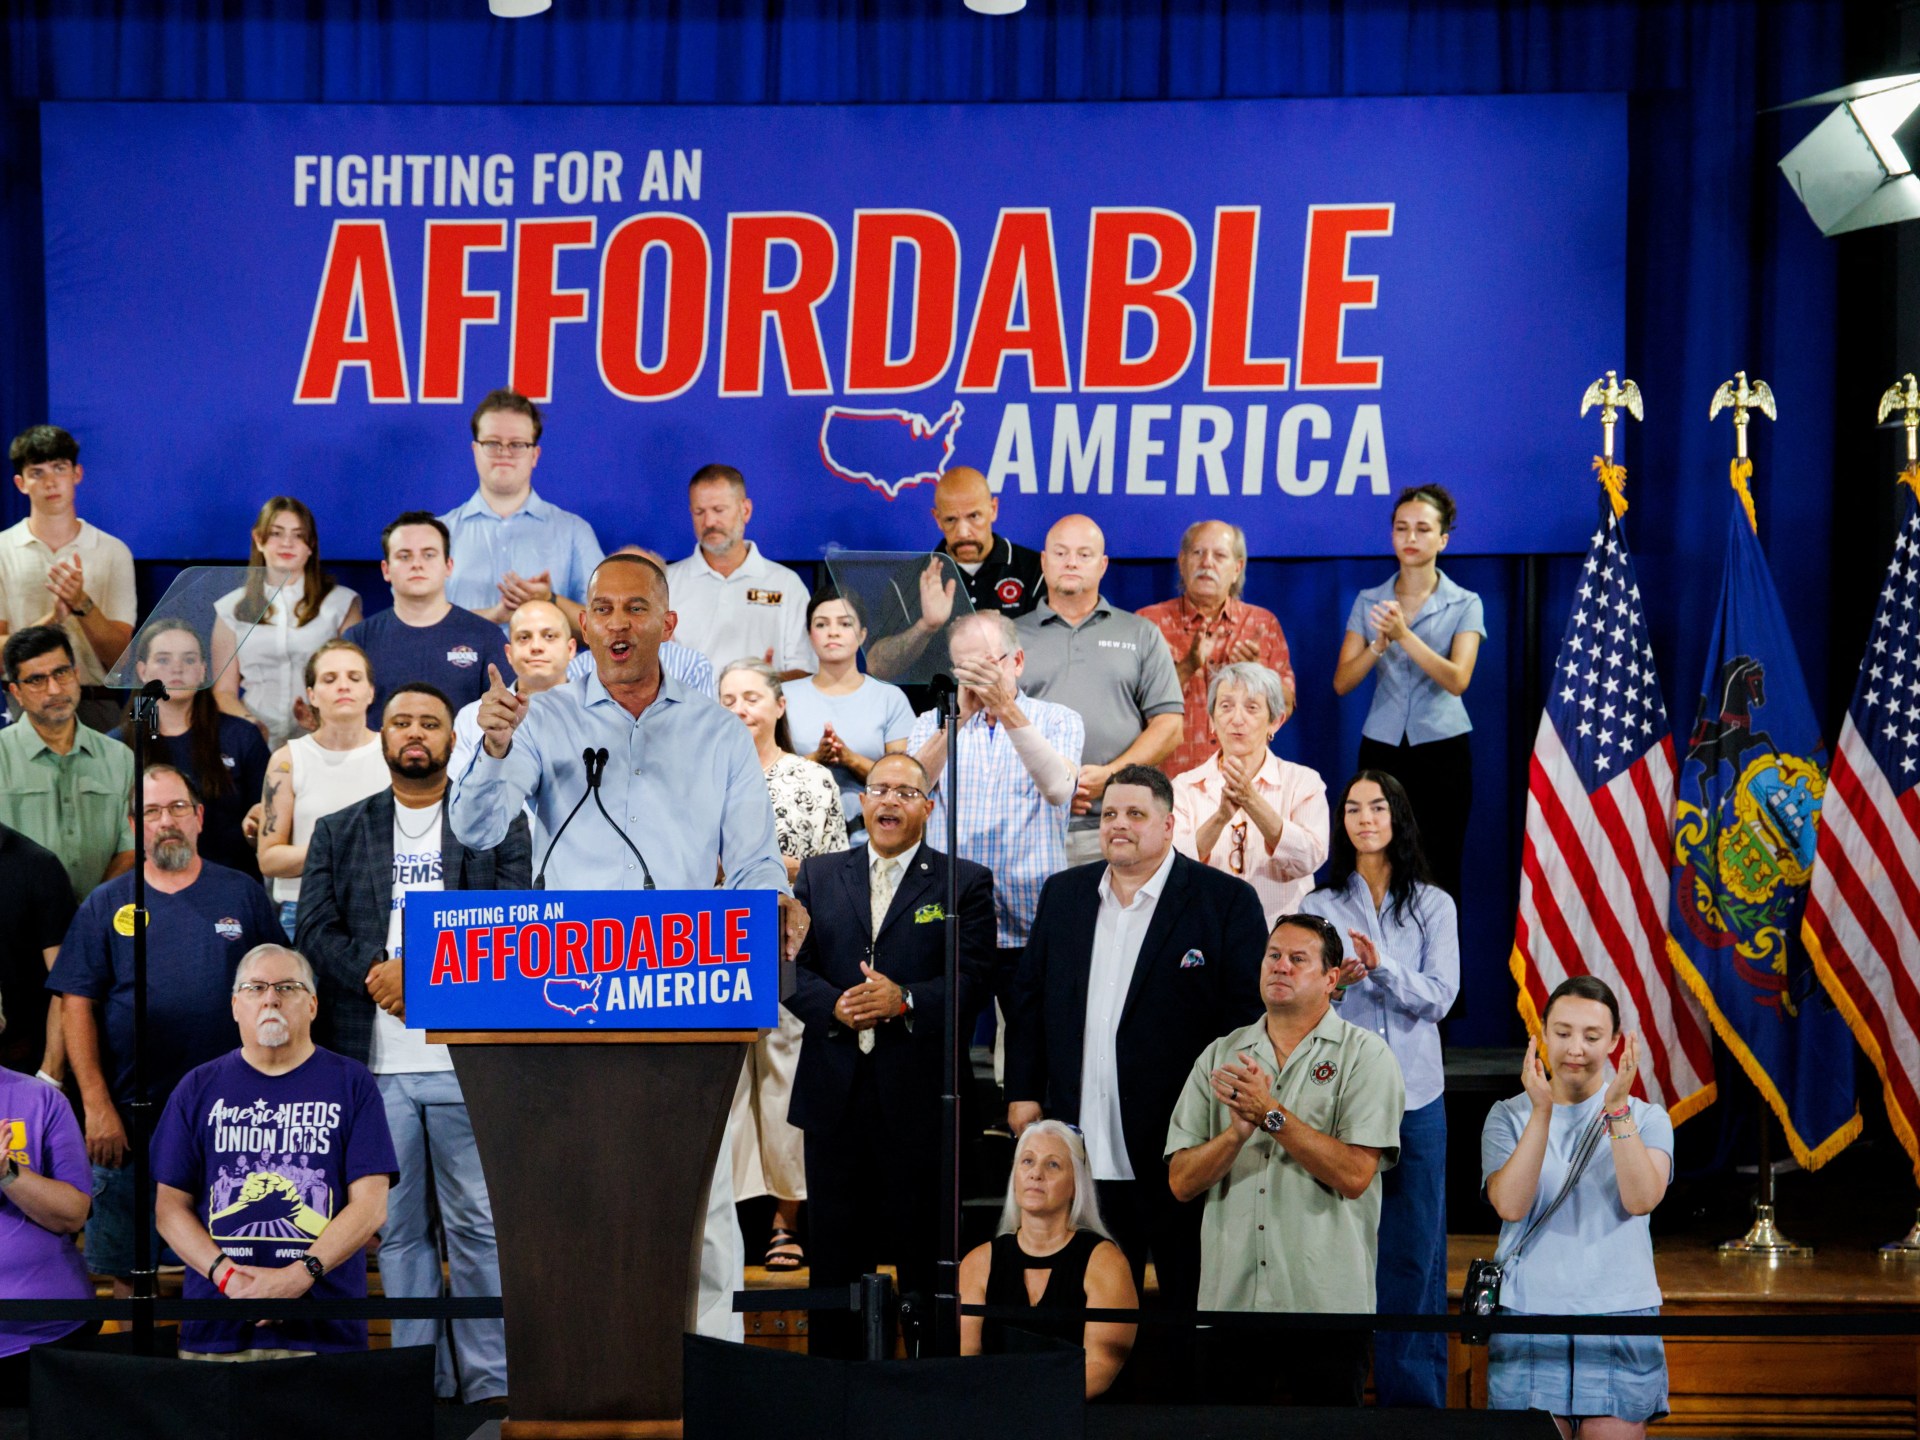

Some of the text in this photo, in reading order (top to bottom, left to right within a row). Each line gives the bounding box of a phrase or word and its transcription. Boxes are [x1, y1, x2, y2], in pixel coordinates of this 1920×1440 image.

[294, 149, 702, 207] FIGHTING FOR AN
[292, 203, 1396, 405] AFFORDABLE
[987, 403, 1391, 497] AMERICA
[1098, 640, 1120, 648] IBEW
[433, 902, 564, 928] FIGHTING FOR AN
[430, 908, 750, 985] AFFORDABLE
[605, 967, 752, 1011] AMERICA
[208, 1098, 341, 1134] America NEEDS
[215, 1126, 331, 1154] UNION JOBS
